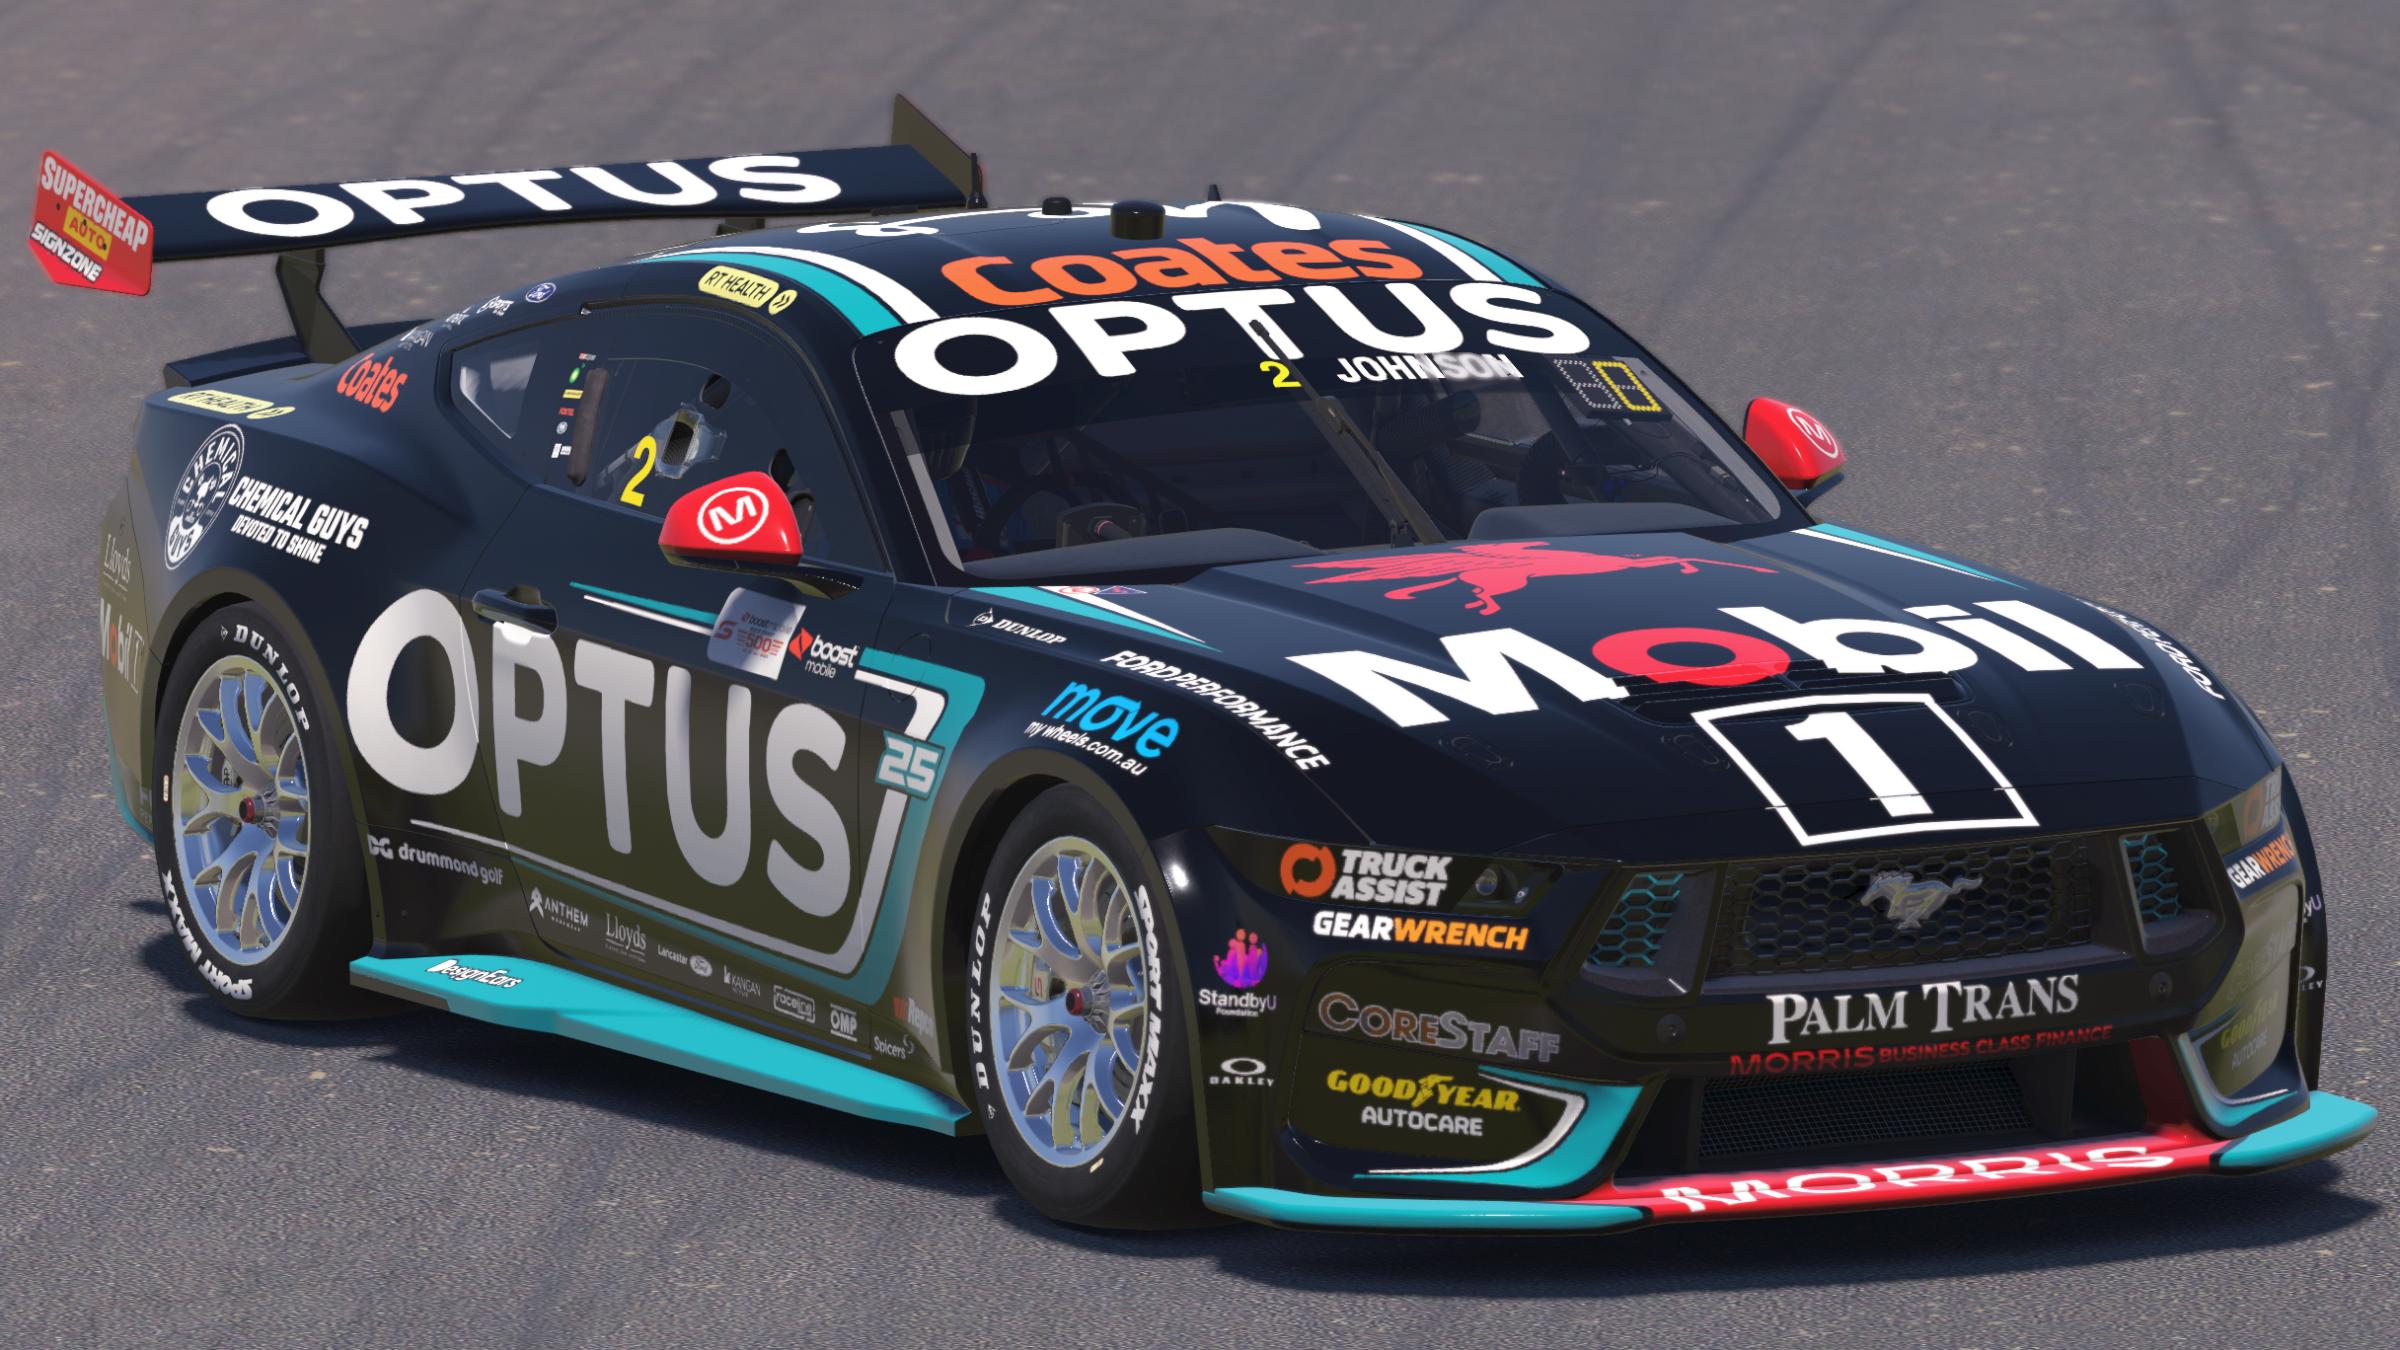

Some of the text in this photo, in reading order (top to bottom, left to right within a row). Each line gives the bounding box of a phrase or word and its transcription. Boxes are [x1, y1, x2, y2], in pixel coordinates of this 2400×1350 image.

[41, 156, 149, 253] SUPERCHEAP
[206, 154, 841, 237] OPTUS
[31, 222, 102, 282] SIGNZONE
[69, 217, 107, 250] AUTO
[704, 271, 771, 301] RT HEALTH
[942, 237, 1422, 306] Coates
[894, 279, 1591, 396] OPTUS
[337, 352, 408, 413] Coates
[1260, 354, 1525, 388] 2 JOHNSON
[182, 436, 237, 503] CHEMICAL
[620, 436, 657, 507] 2
[228, 476, 370, 550] CHEMICAL GUYS
[230, 514, 327, 565] DEVOTED TO SHINE
[100, 598, 133, 682] Mobil
[810, 634, 859, 669] boost
[992, 618, 1067, 646] DUNLOP
[234, 624, 310, 731] DUNLOP
[805, 659, 836, 679] mobile
[1285, 600, 2144, 729] Mobil
[1040, 680, 1180, 759] move
[347, 588, 851, 918] OPTUS
[877, 737, 938, 796] 25
[1024, 721, 1148, 776] my wheels.com.au
[1785, 711, 1934, 818] 1
[367, 834, 504, 886] DG drummond golf
[1340, 849, 1453, 881] TRUCK
[162, 870, 203, 964] MAXX
[544, 896, 589, 927] ANTHEM
[1331, 876, 1448, 907] ASSIST
[605, 912, 647, 951] Lloyds
[657, 944, 689, 966] Lancaster
[1134, 884, 1162, 1011] SPORT
[1312, 910, 1529, 951] GEARWRENCH
[199, 959, 253, 1000] SPORT
[426, 958, 524, 990] DesignEars
[969, 892, 991, 1091] DUNLOP
[1199, 988, 1278, 1013] StandbyU
[775, 991, 813, 1018] raceline
[830, 1009, 858, 1036] OMP
[1766, 974, 2079, 1045] PALM TRANS
[873, 1035, 907, 1060] Spicers
[1130, 1012, 1162, 1136] MAXX
[1728, 1024, 2114, 1076] MORRIS BUSINESS CLASS FINANCE
[1209, 1075, 1275, 1088] OAKLEY
[1361, 1105, 1483, 1138] AUTOCARE
[1660, 1146, 2176, 1213] MORRIS
